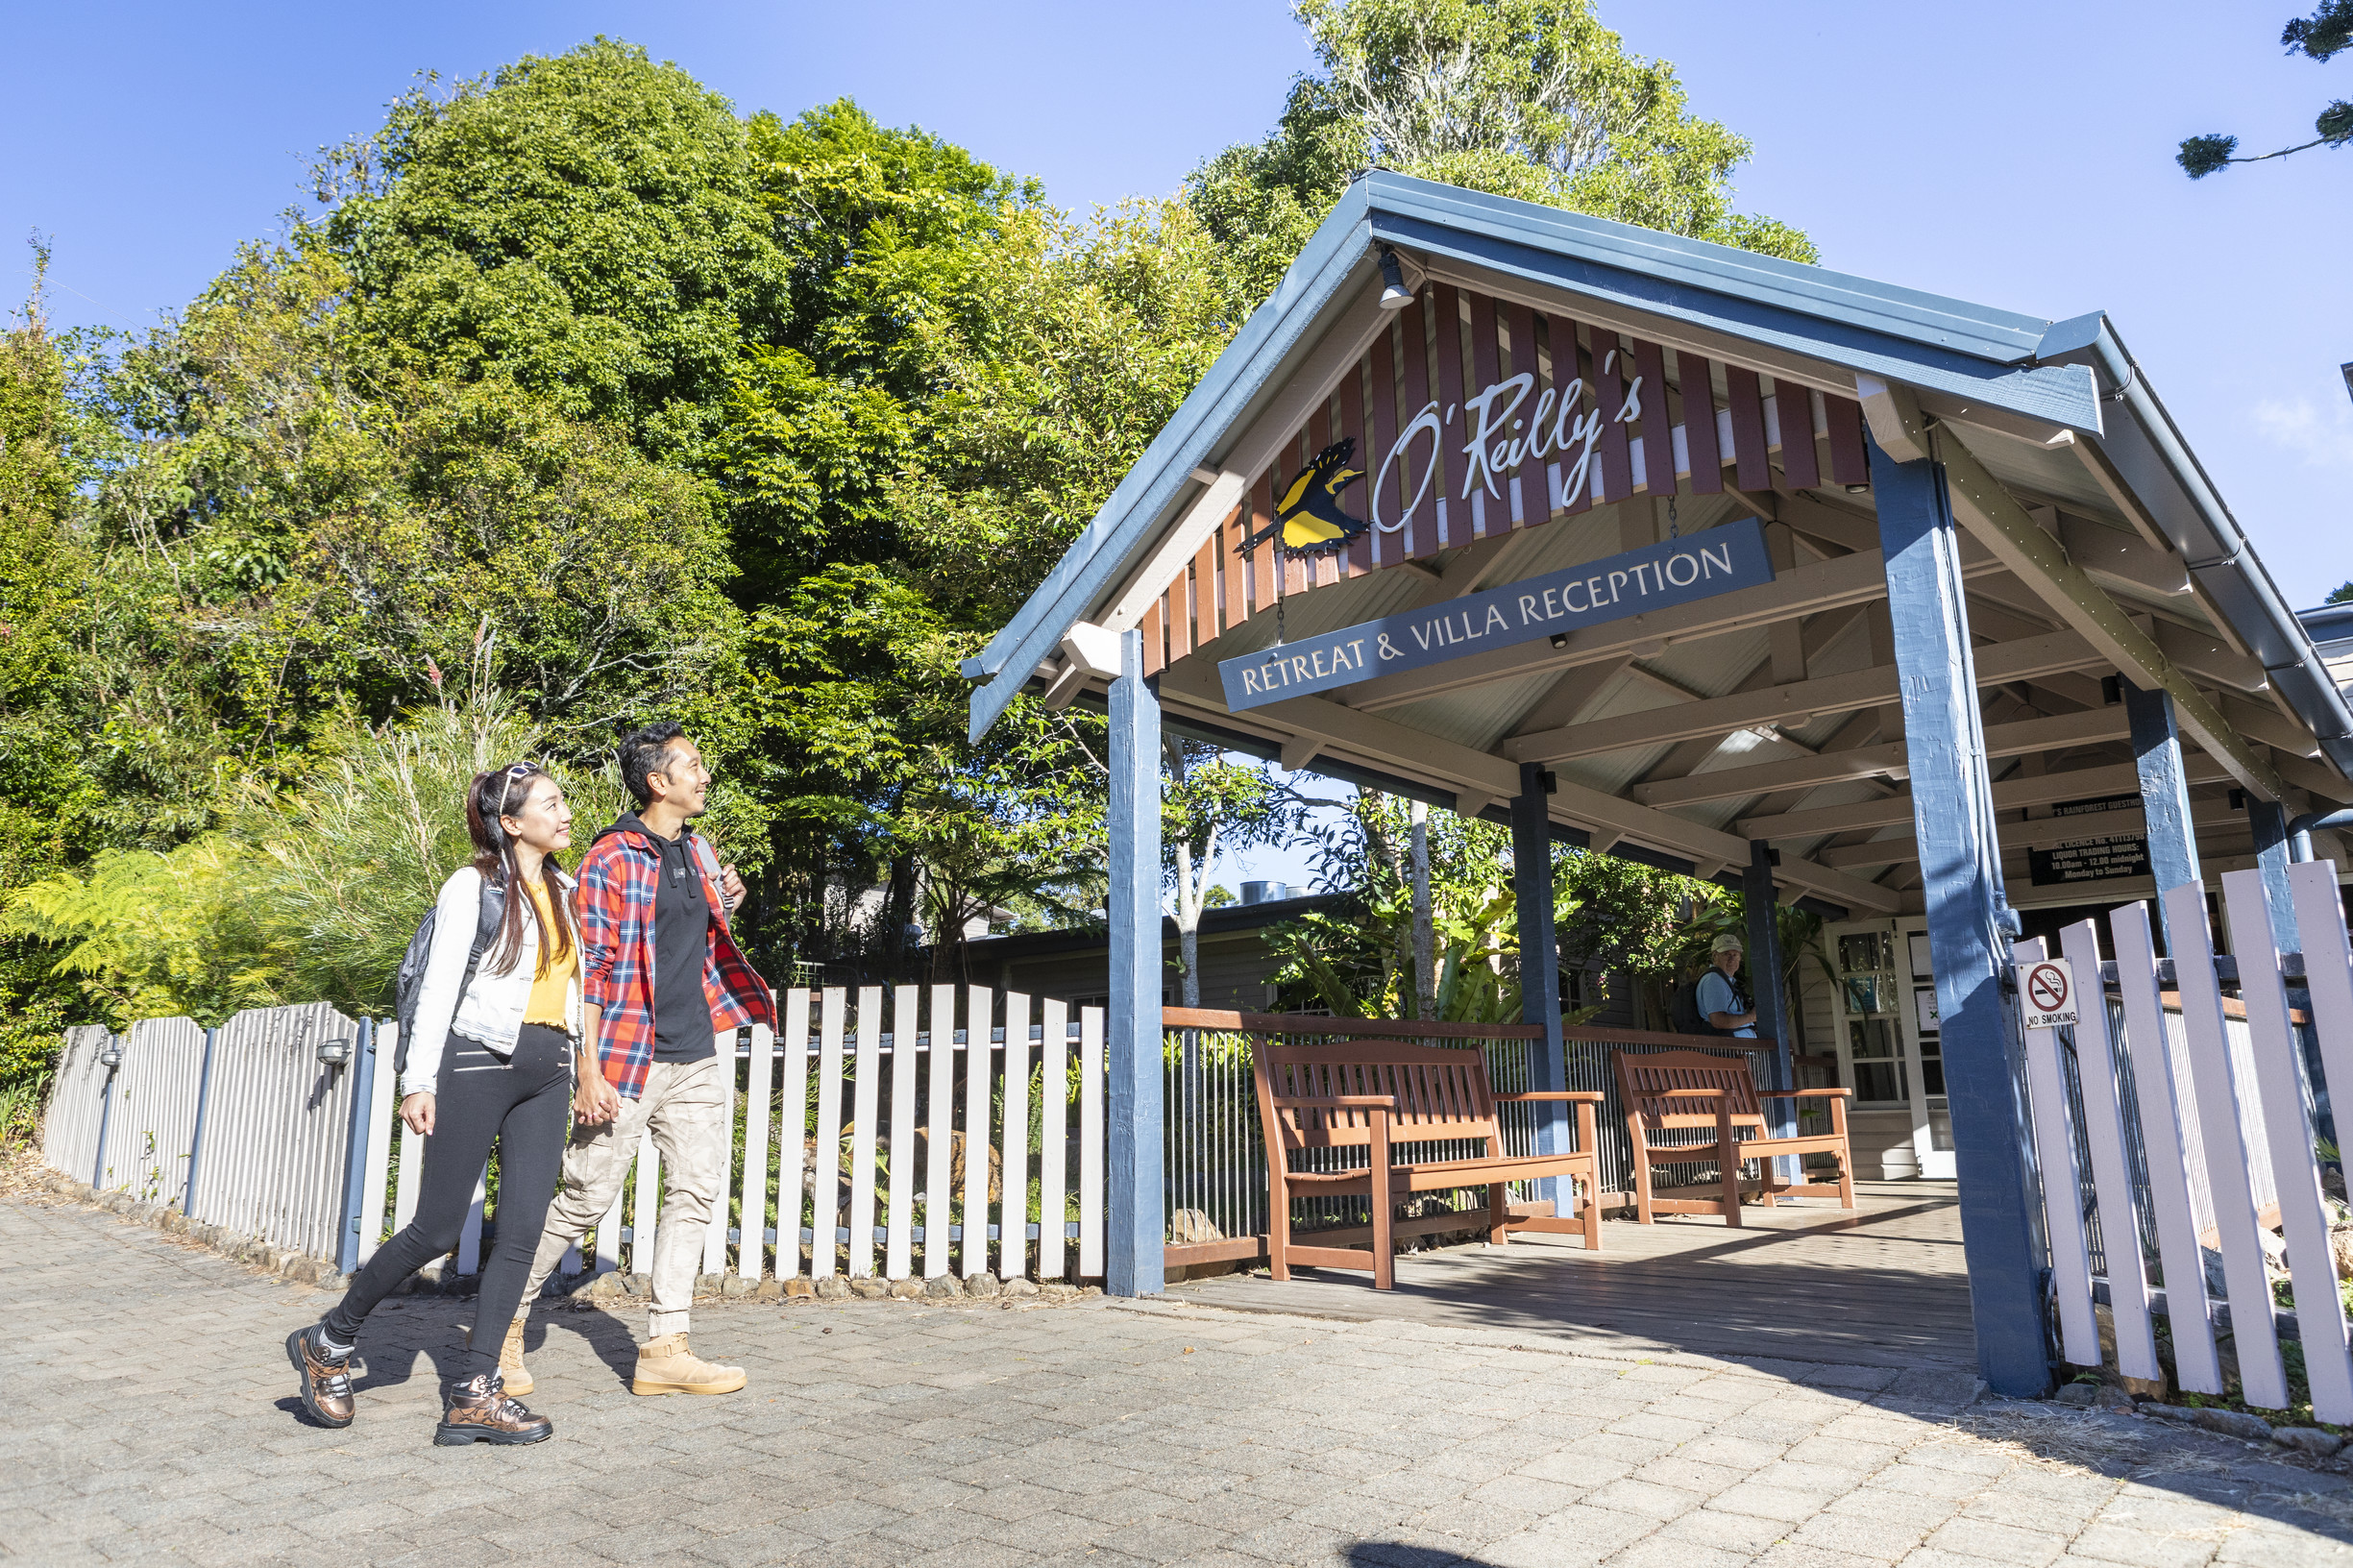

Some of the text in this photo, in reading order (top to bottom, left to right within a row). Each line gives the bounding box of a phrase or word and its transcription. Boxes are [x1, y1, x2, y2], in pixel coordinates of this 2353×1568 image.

[1372, 349, 1644, 533] O'Reilly's
[1241, 542, 1732, 695] RETREAT & VILLA RECEPTION
[2064, 802, 2107, 815] RAINFOREST
[2052, 844, 2140, 861] LIQUOR TRADING HOURS:
[2051, 860, 2083, 870] 10.00am
[2089, 856, 2110, 867] 12.00
[2111, 853, 2145, 864] midnight
[2065, 868, 2095, 879] Monday
[2105, 865, 2133, 874] Sunday
[2028, 1012, 2076, 1025] NO SMOKING
